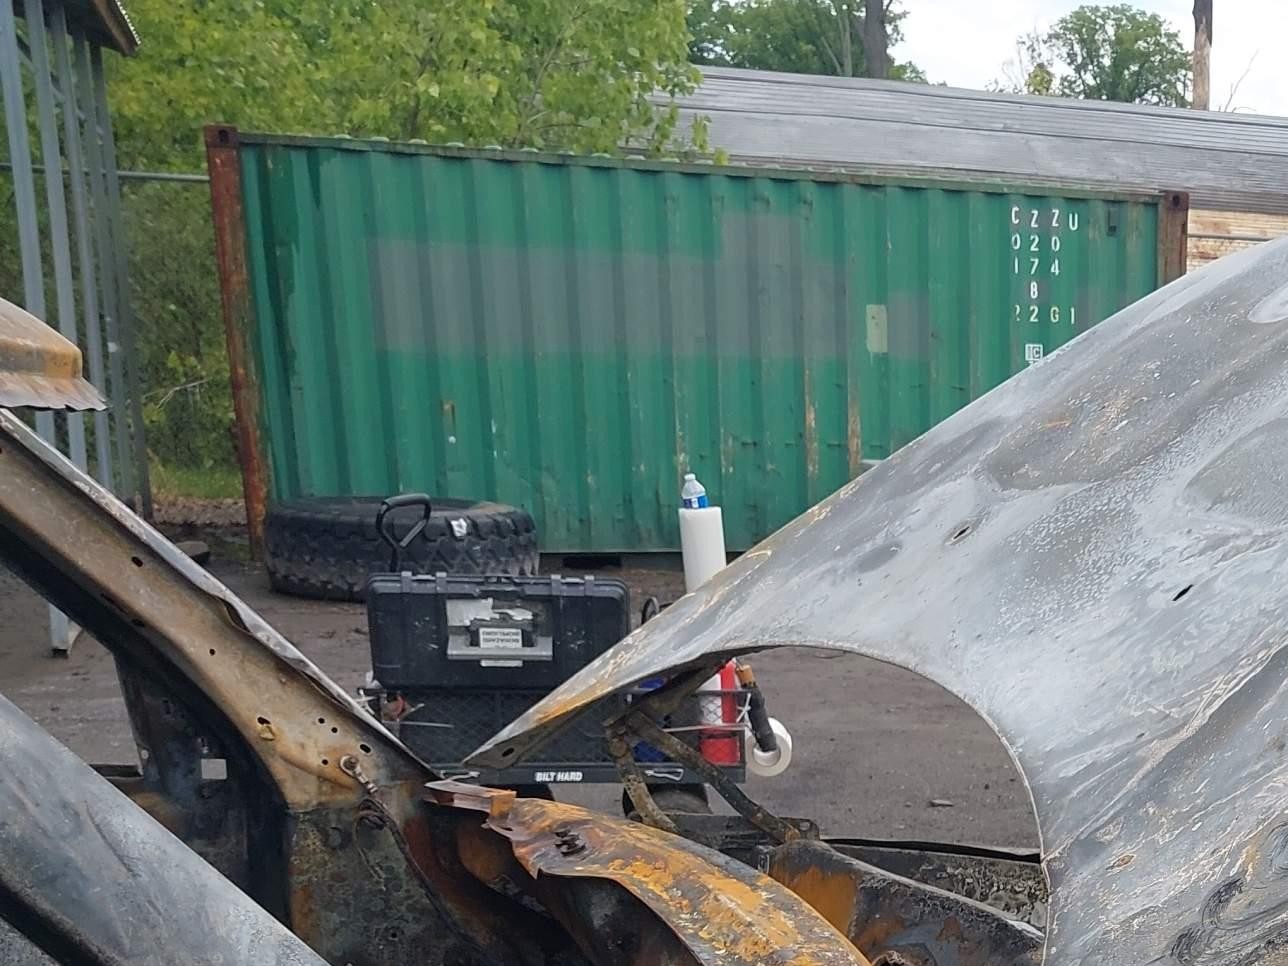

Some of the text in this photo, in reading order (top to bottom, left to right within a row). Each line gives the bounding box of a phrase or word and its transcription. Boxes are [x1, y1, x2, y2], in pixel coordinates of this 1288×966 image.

[1030, 281, 1039, 299] 8
[535, 771, 583, 782] BILT HARD
